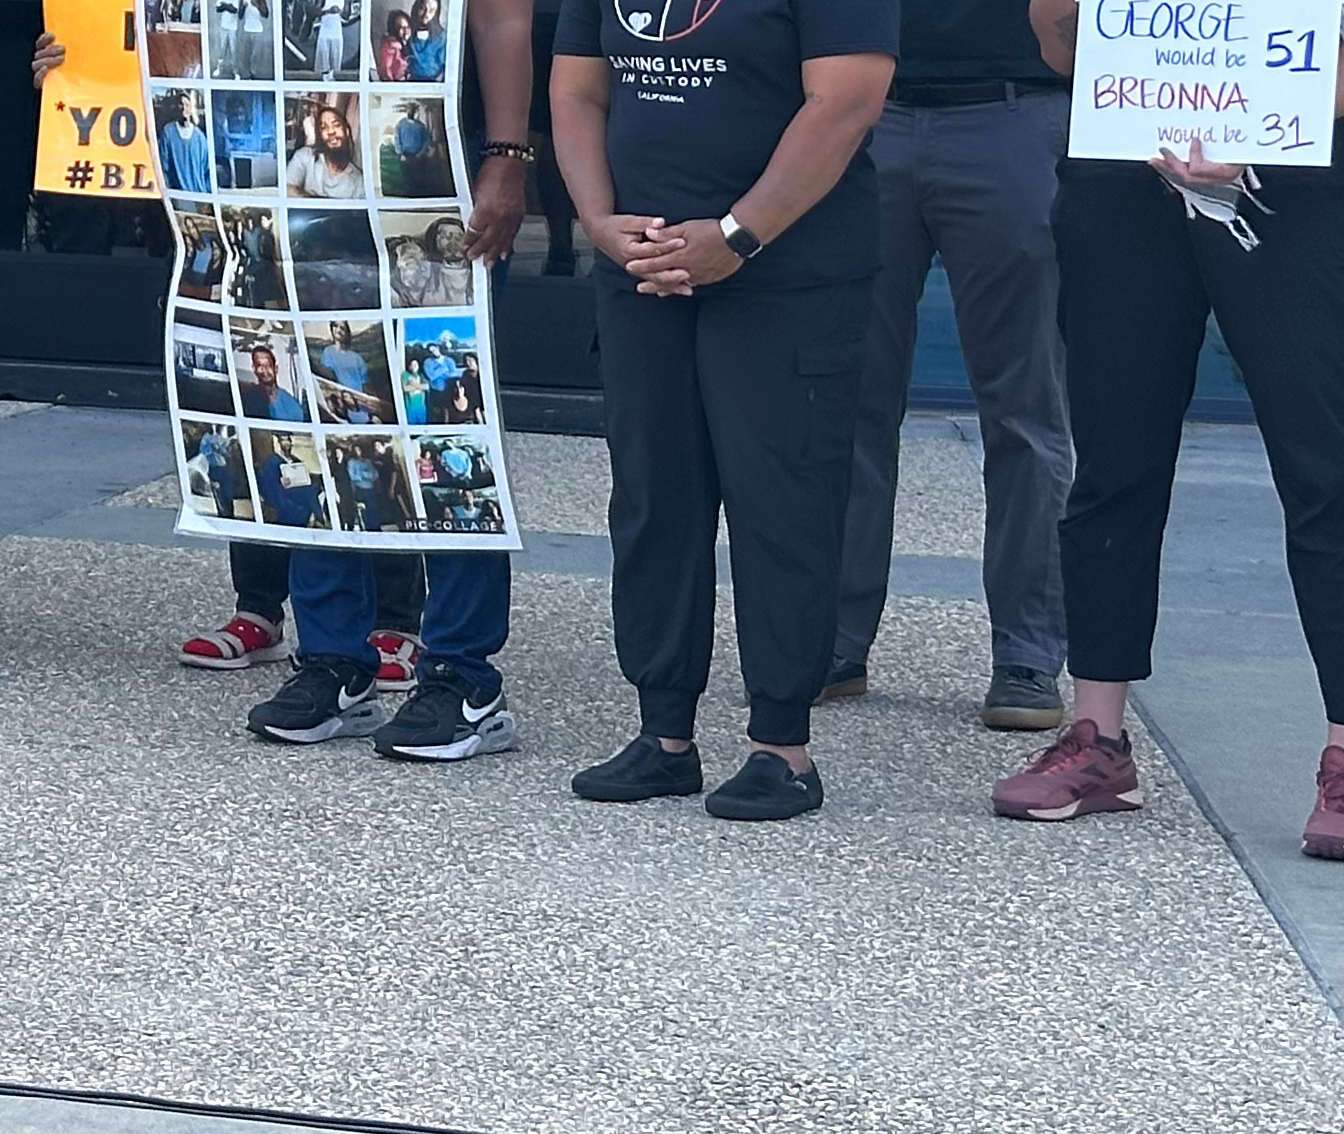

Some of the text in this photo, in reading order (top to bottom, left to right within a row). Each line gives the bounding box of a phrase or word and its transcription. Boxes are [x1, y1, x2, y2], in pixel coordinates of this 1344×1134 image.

[670, 56, 728, 72] LIVES
[1155, 30, 1321, 72] would be 51
[621, 72, 635, 83] IN
[1093, 74, 1249, 113] BREONNA
[69, 106, 150, 147] YO
[1157, 113, 1315, 151] would be 31
[65, 160, 155, 190] #BL
